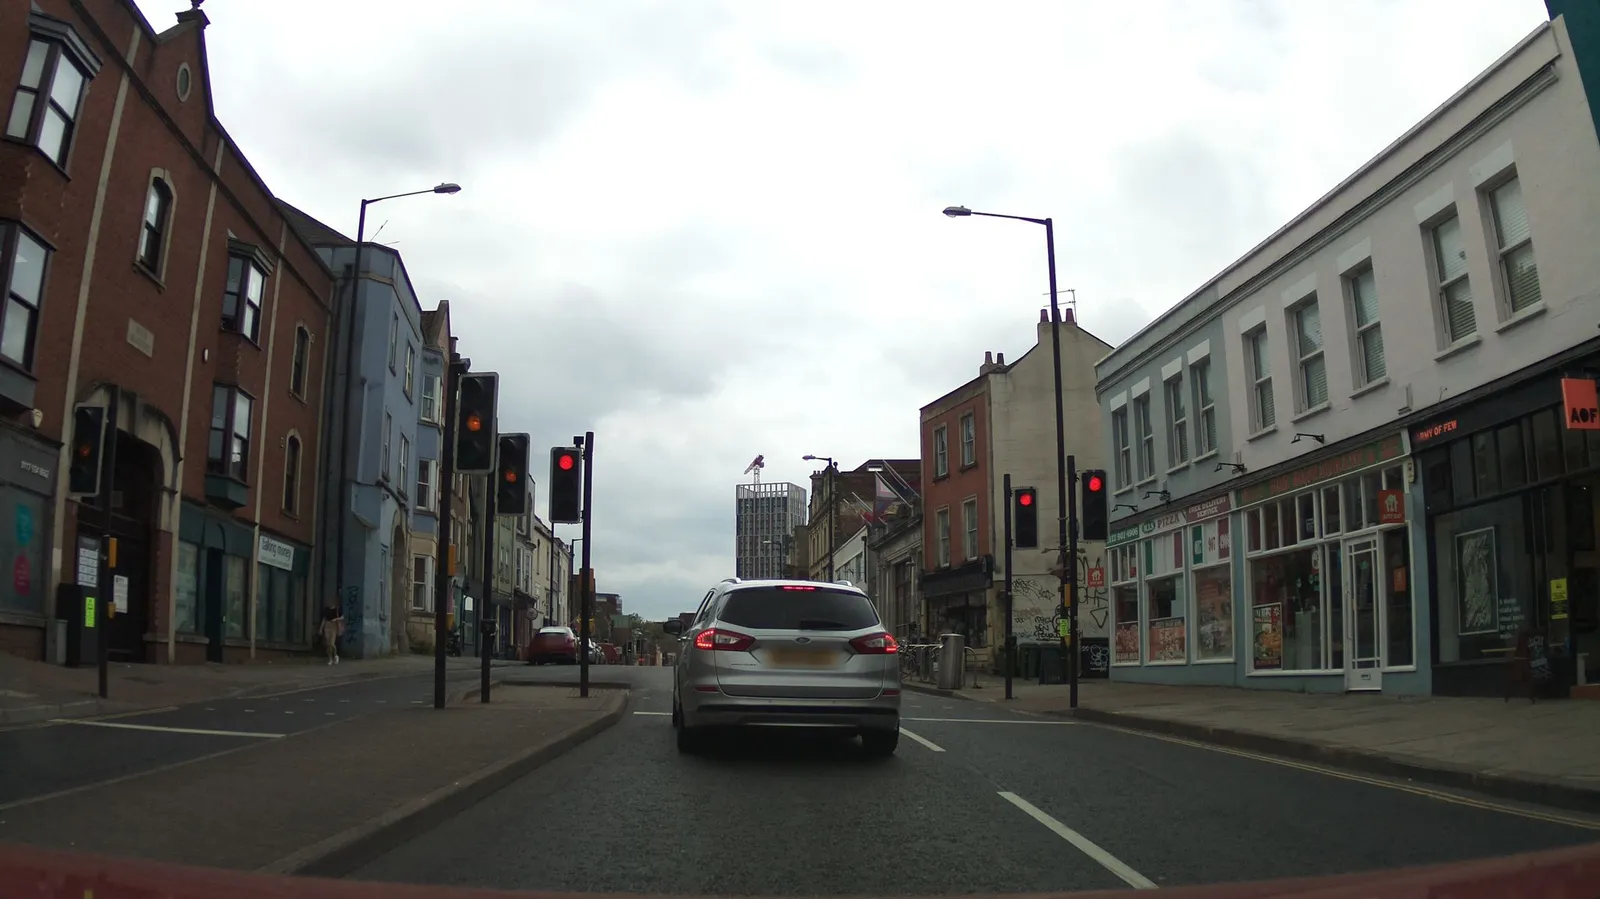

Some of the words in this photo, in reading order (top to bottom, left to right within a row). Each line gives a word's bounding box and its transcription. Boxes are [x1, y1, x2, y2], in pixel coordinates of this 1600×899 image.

[1571, 407, 1597, 424] AOF
[1433, 425, 1443, 436] OF
[1443, 419, 1458, 433] FEW
[1157, 513, 1180, 529] PIZZA
